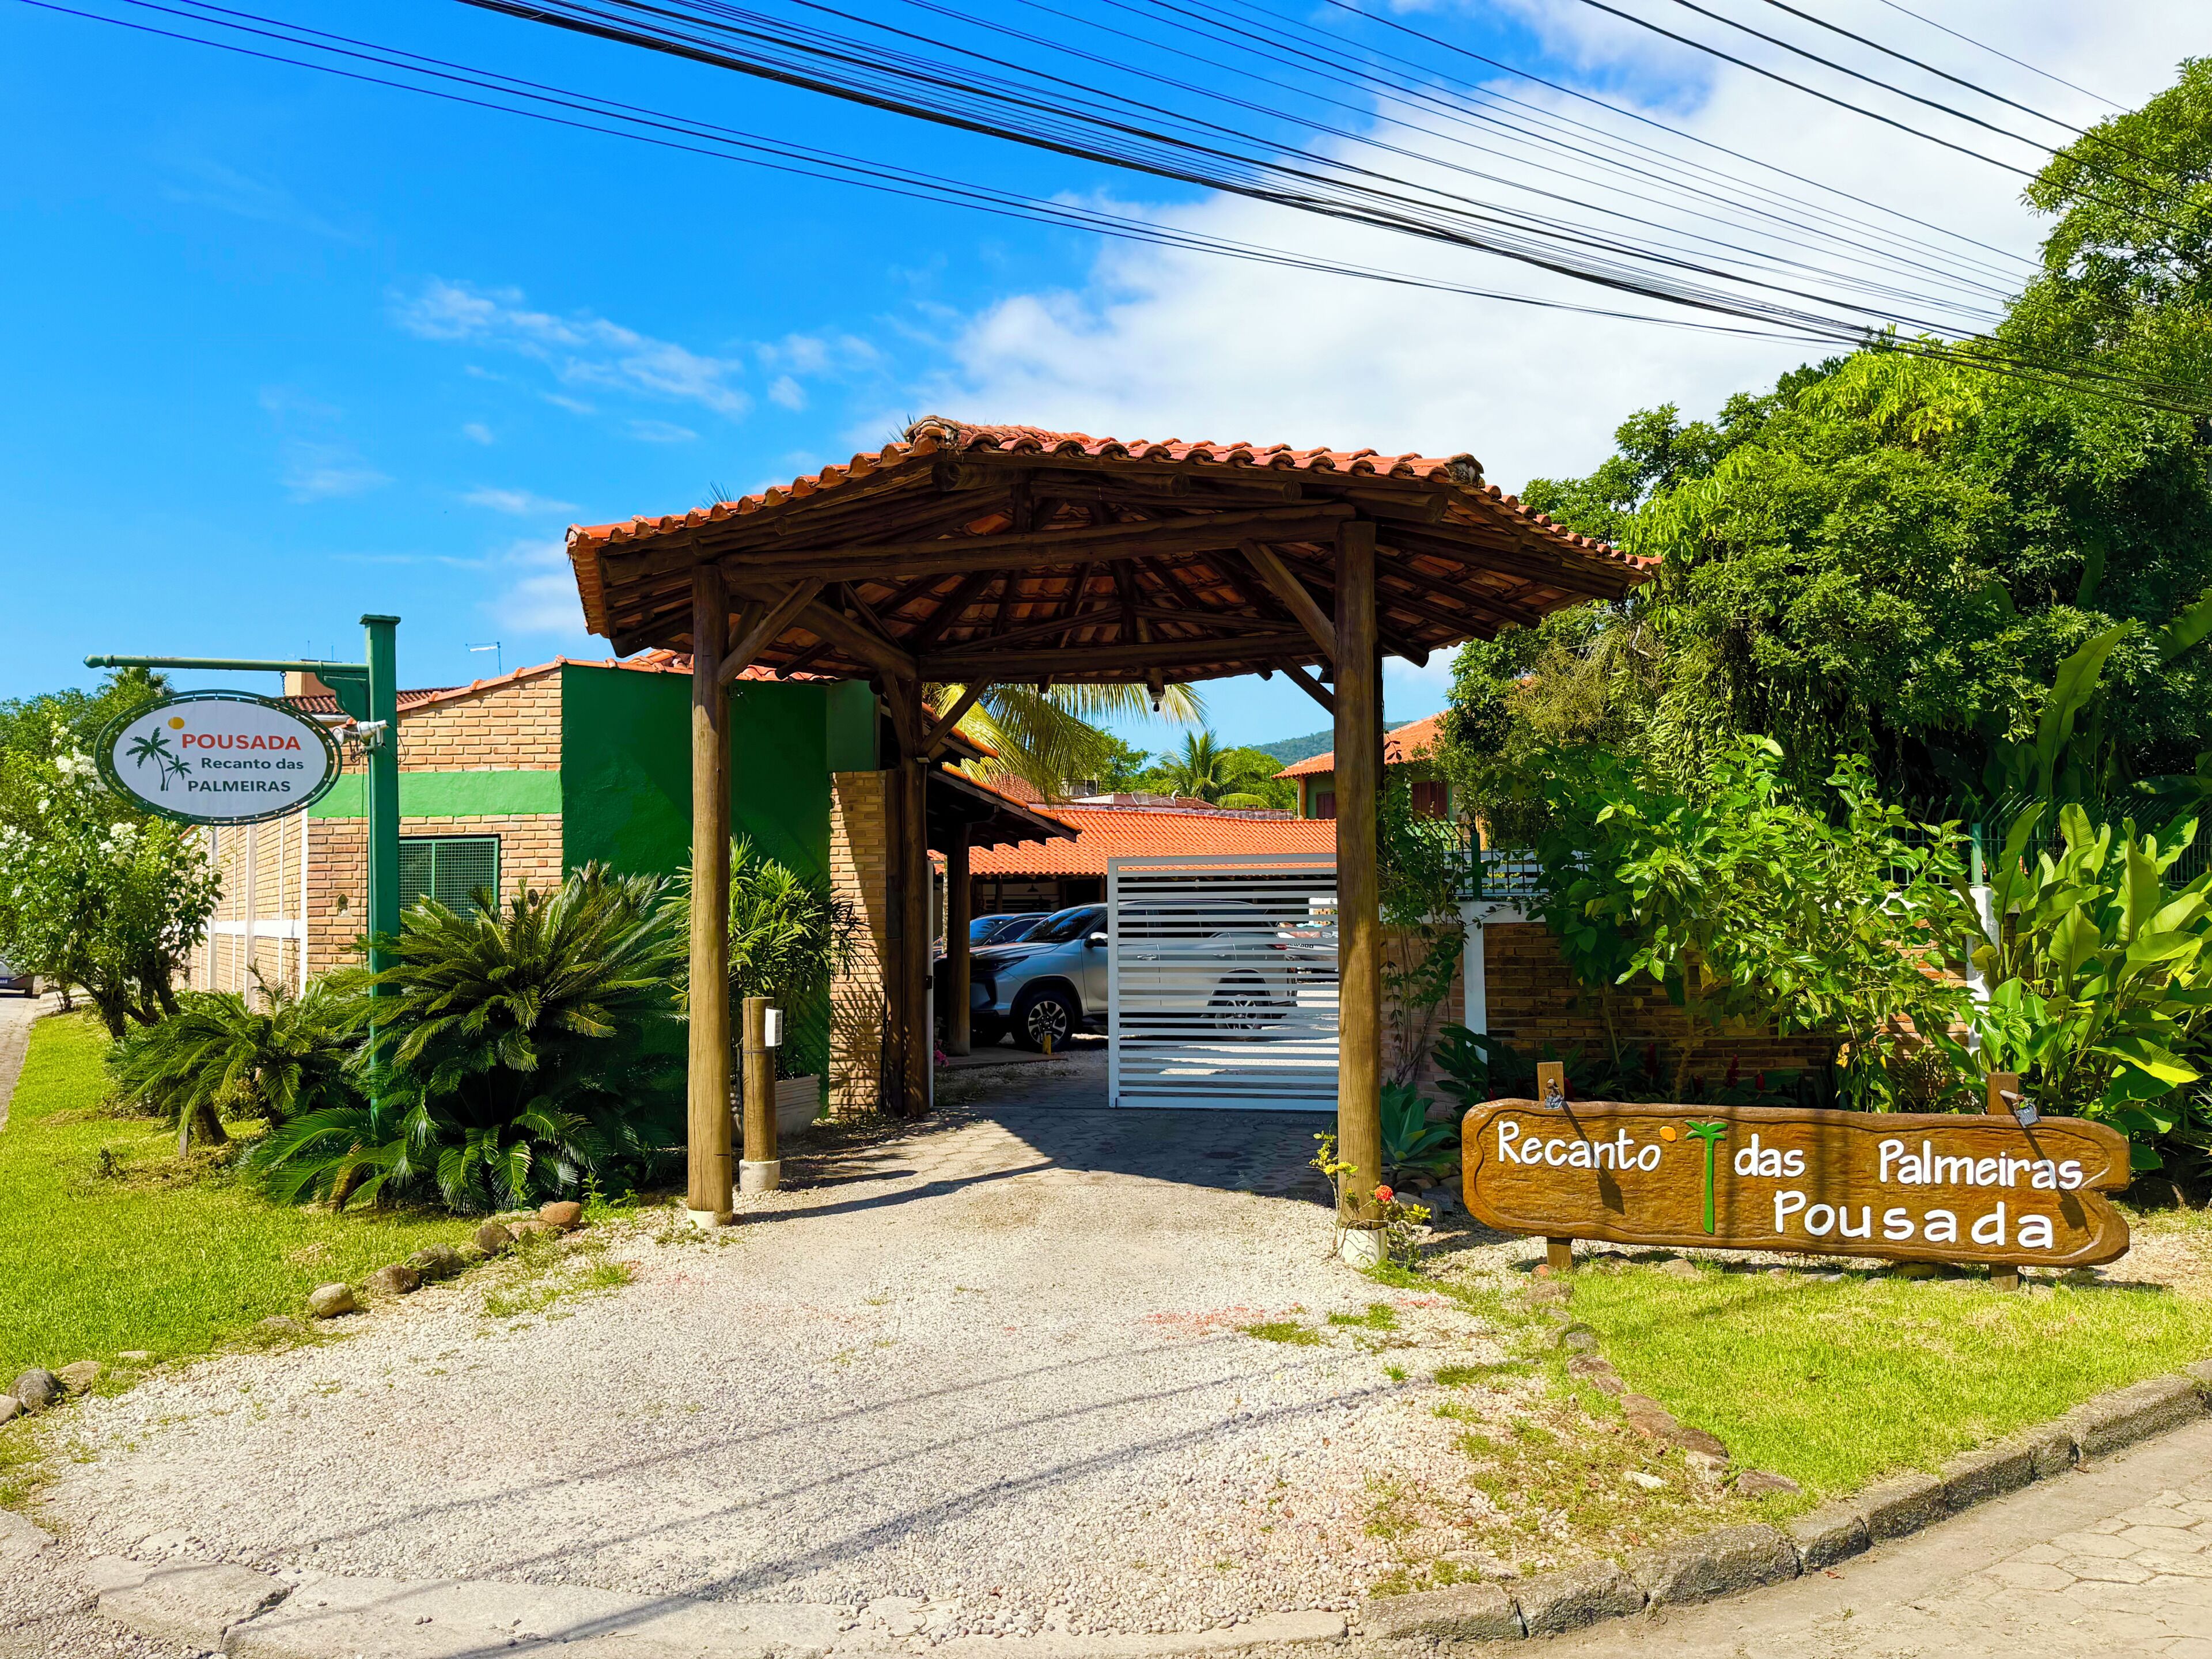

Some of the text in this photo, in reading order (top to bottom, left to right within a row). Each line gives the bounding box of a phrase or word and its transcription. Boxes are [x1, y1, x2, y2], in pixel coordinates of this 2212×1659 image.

[182, 733, 301, 751] POUSADA
[201, 757, 304, 770] Recanto das
[188, 781, 291, 792] PALMEIRAS
[1497, 1120, 2084, 1190] Recanto das Palmeiras
[1773, 1190, 2054, 1249] Pousada
